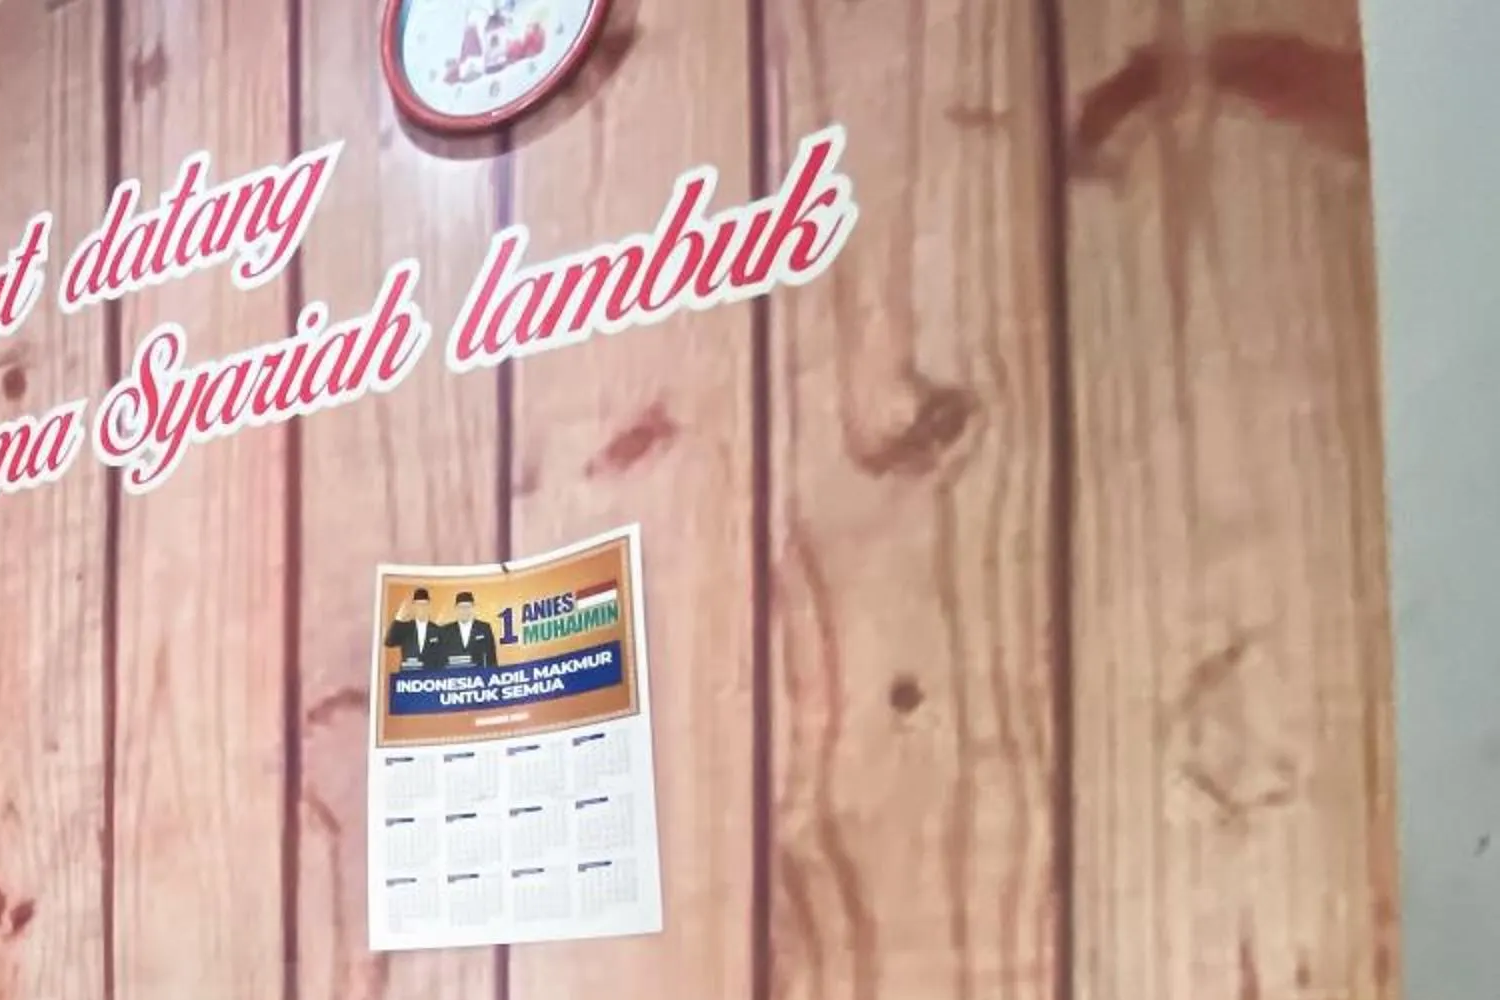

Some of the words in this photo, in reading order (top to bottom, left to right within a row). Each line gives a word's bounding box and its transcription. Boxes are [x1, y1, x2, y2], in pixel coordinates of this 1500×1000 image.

[64, 159, 330, 304] datang
[98, 268, 422, 487] Syariah
[455, 139, 844, 362] lambuk
[498, 607, 519, 645] 1
[521, 591, 575, 624] ANIES
[522, 600, 619, 645] MUHAIMIN
[395, 675, 485, 694] INDONESIA
[487, 669, 530, 687] ADIL
[533, 650, 613, 681] MAKMUR
[440, 687, 499, 705] UNTUK
[501, 678, 565, 701] SEMUA
